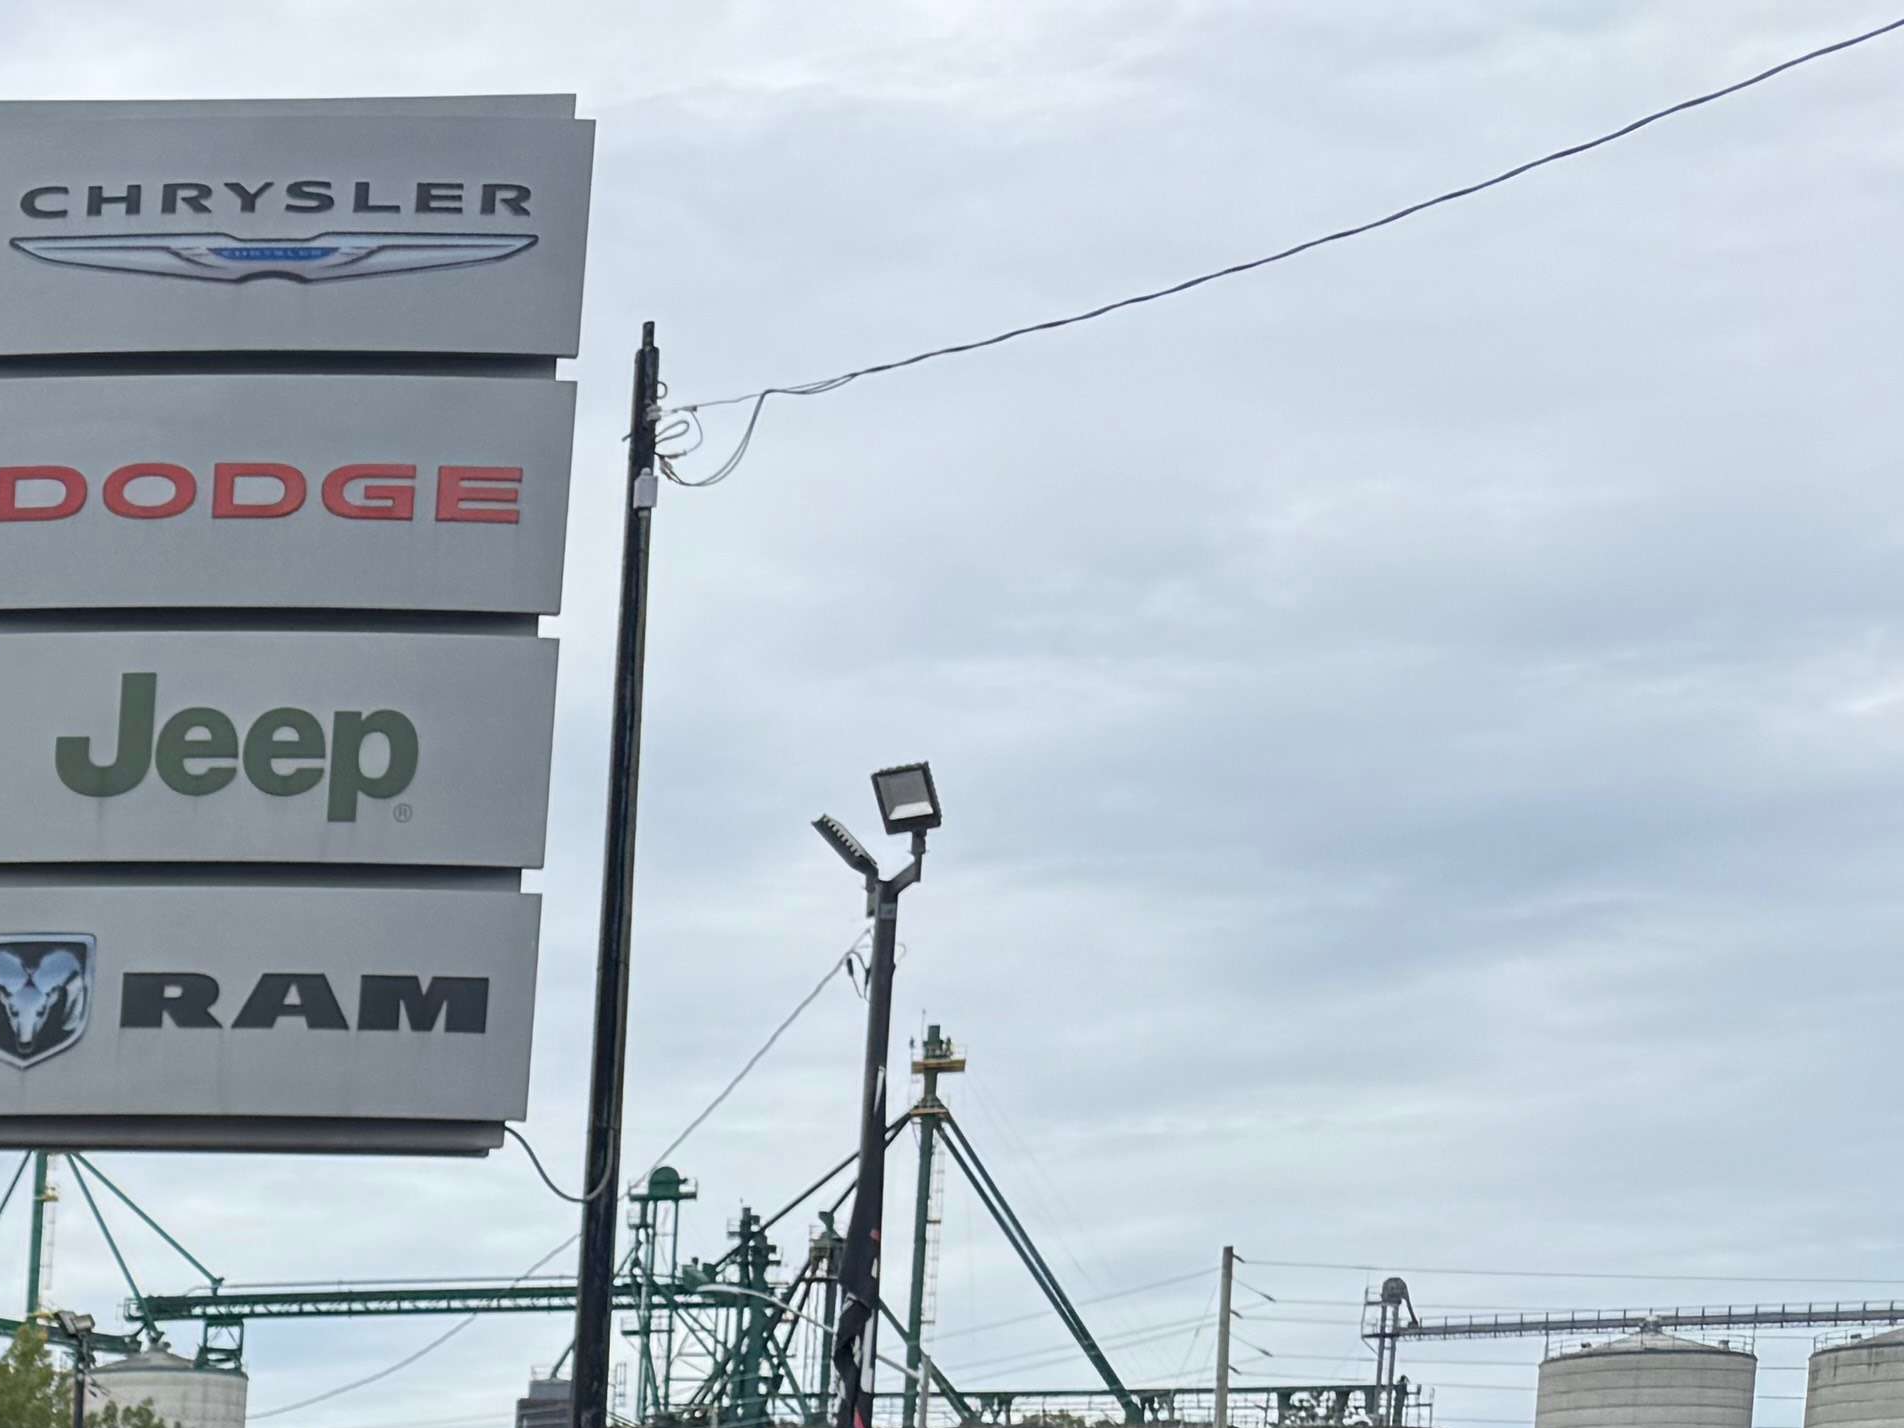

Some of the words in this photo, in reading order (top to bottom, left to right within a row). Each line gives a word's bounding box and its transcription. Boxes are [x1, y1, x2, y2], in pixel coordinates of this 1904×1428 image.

[19, 180, 533, 220] CHRYSLER
[55, 672, 419, 822] Jeep
[120, 971, 491, 1035] RAM
